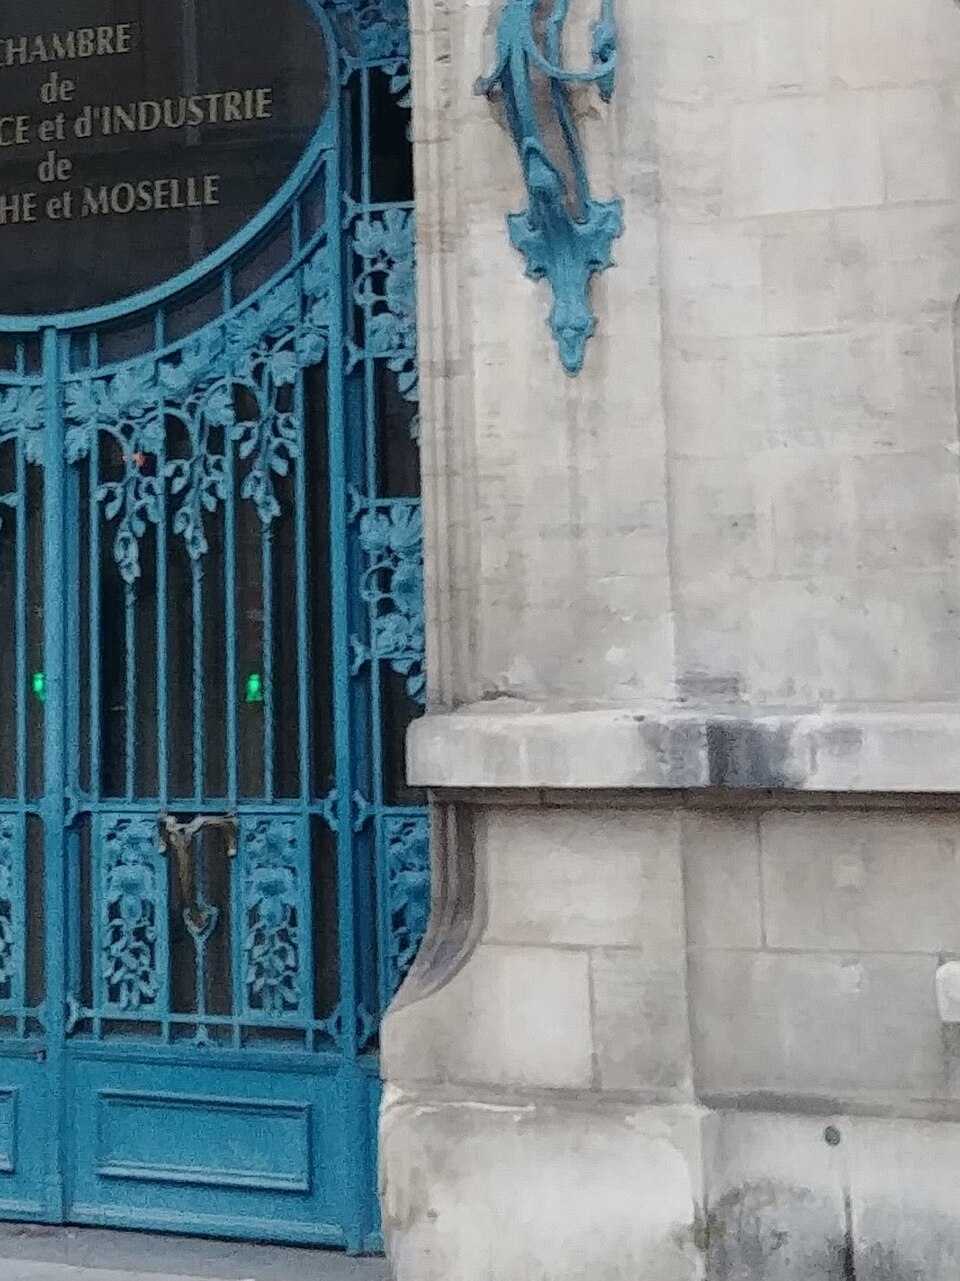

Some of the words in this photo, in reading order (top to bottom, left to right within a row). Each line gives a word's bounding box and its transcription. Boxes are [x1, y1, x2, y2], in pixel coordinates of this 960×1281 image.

[41, 72, 75, 103] de
[39, 113, 65, 141] et
[75, 88, 272, 138] d'INDUSTRIE
[38, 150, 72, 182] de
[46, 190, 73, 219] et
[81, 175, 220, 217] MOSELLE
